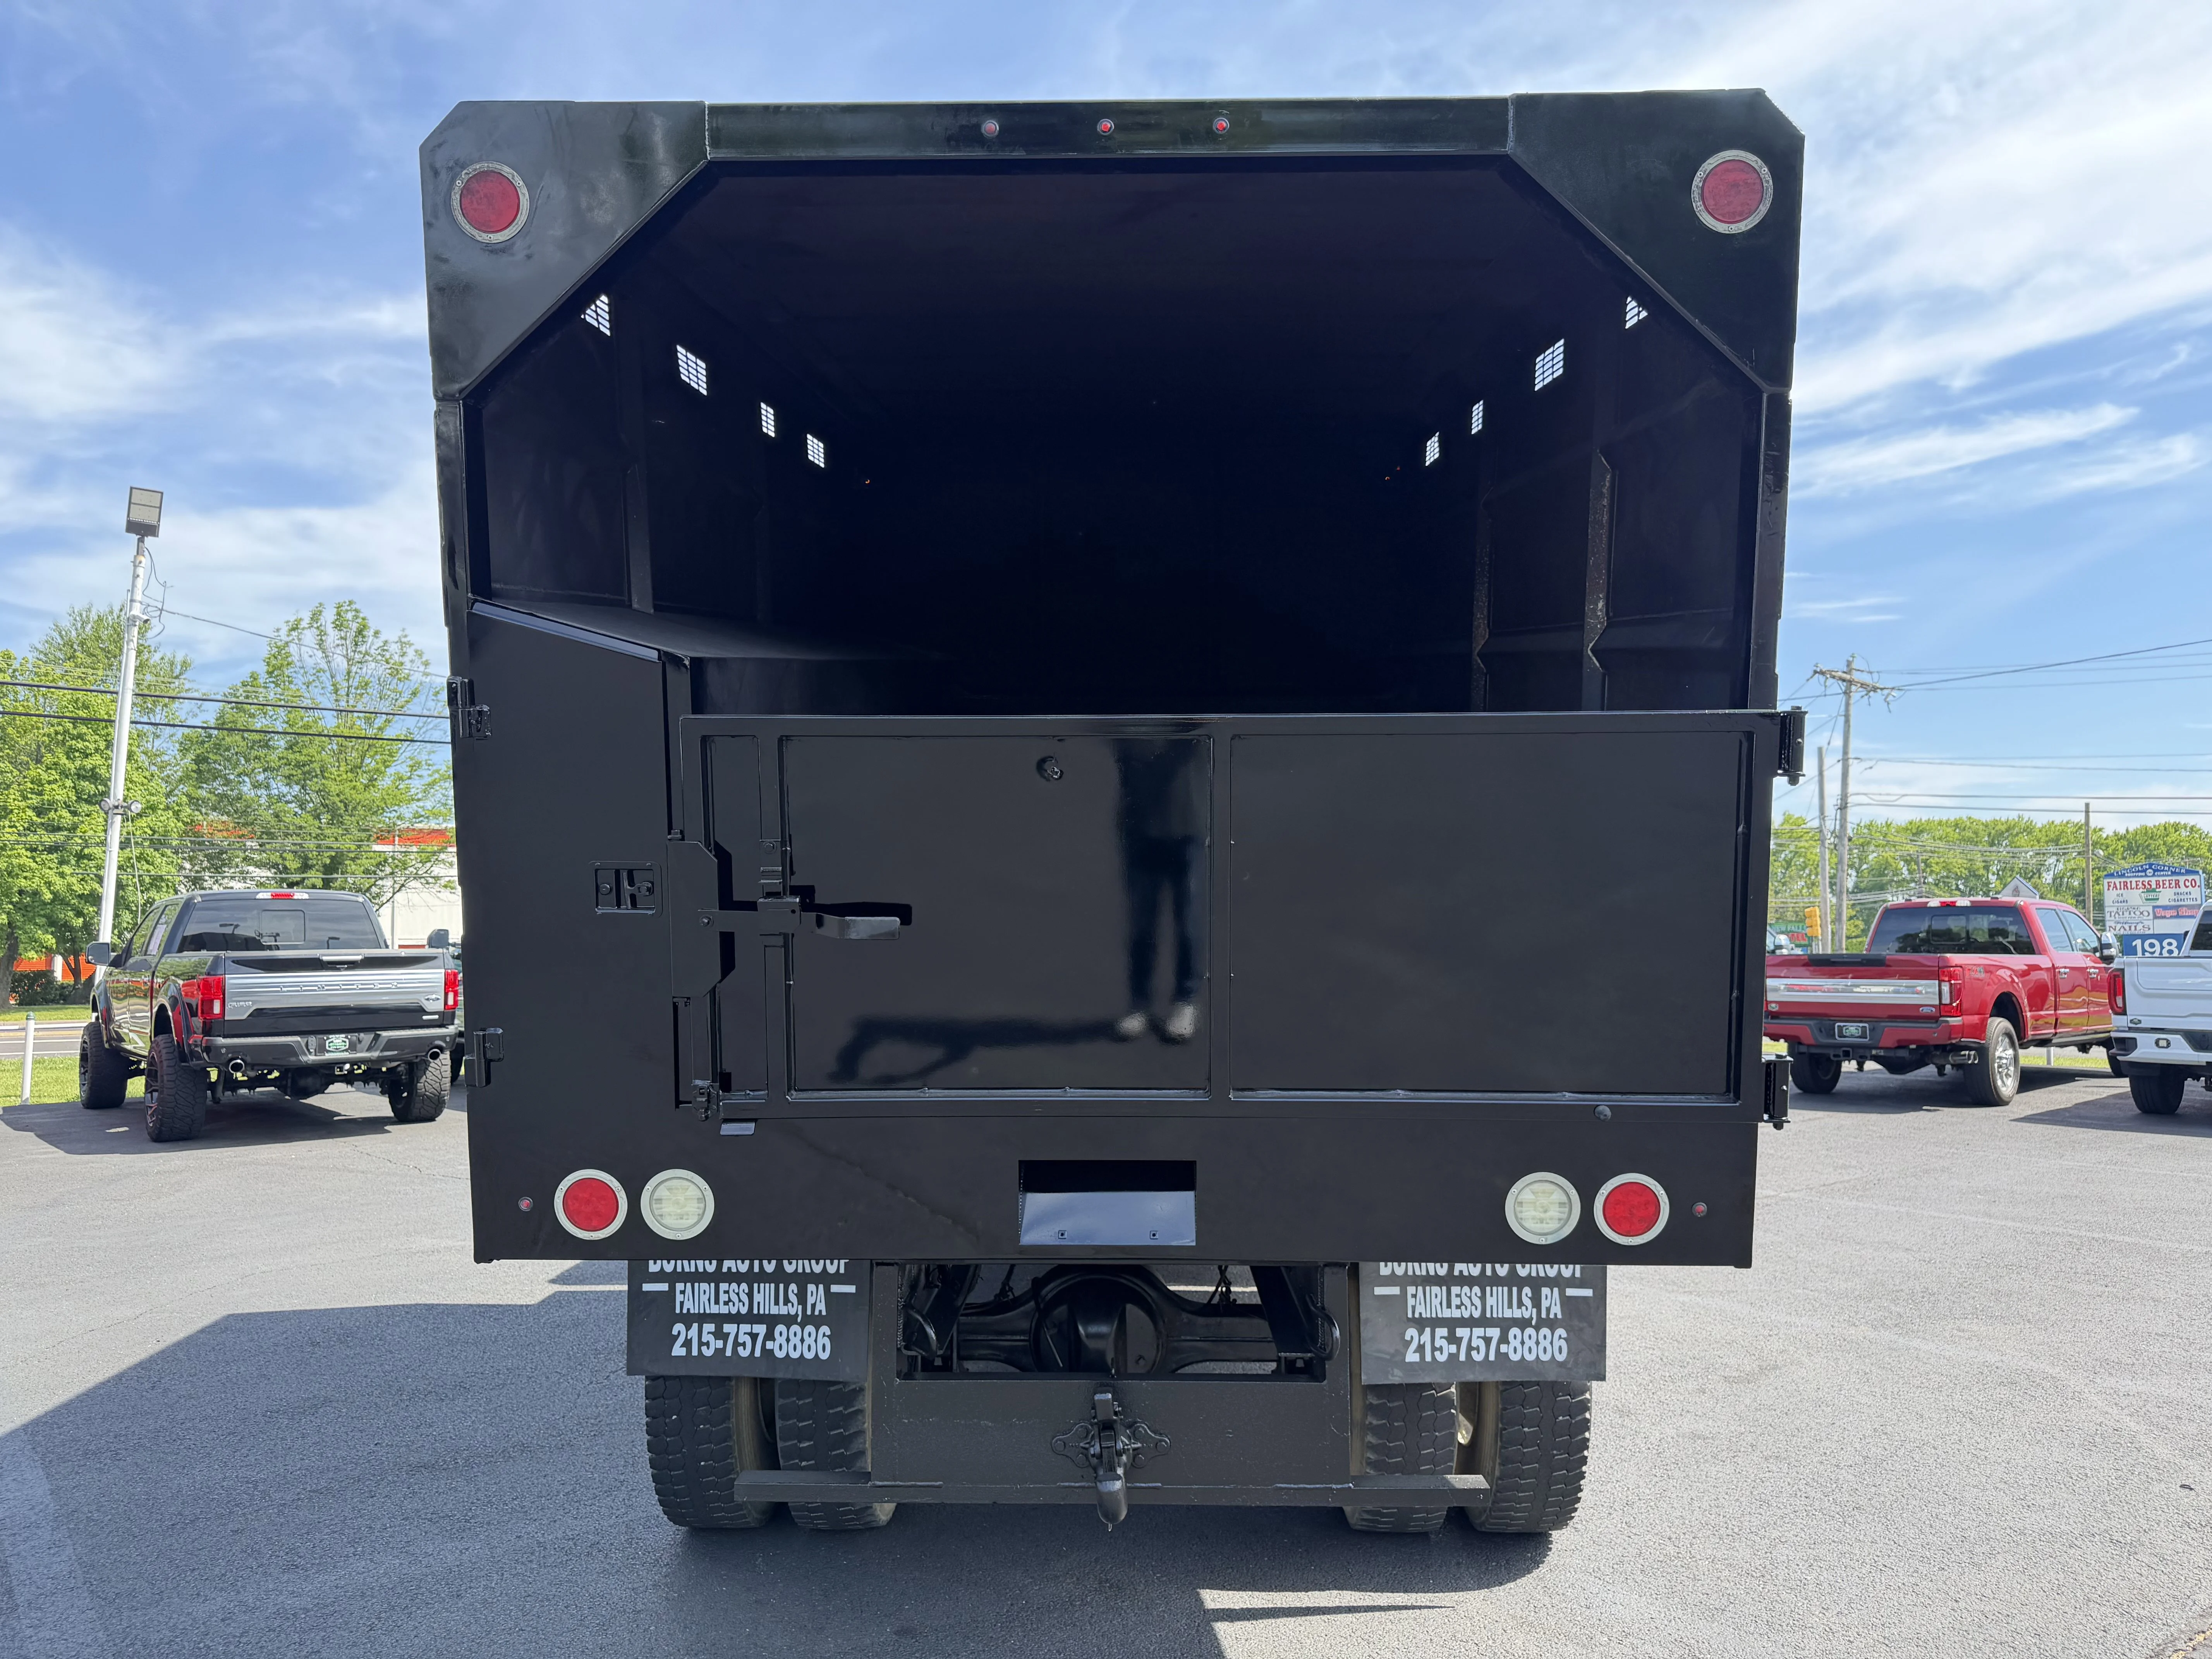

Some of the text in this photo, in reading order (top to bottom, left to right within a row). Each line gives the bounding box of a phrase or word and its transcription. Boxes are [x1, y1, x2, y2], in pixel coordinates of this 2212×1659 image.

[2107, 878, 2200, 891] FAIRLESS BEER CO.
[2152, 864, 2185, 873] CORNER
[2132, 939, 2178, 956] 198
[675, 1283, 826, 1322] FAIRLESS HILLS, PA
[1407, 1286, 1562, 1325] FAIRLESS HILLS, PA
[671, 1322, 831, 1360] 215-757-8886
[1404, 1327, 1568, 1362] 215-757-8886
